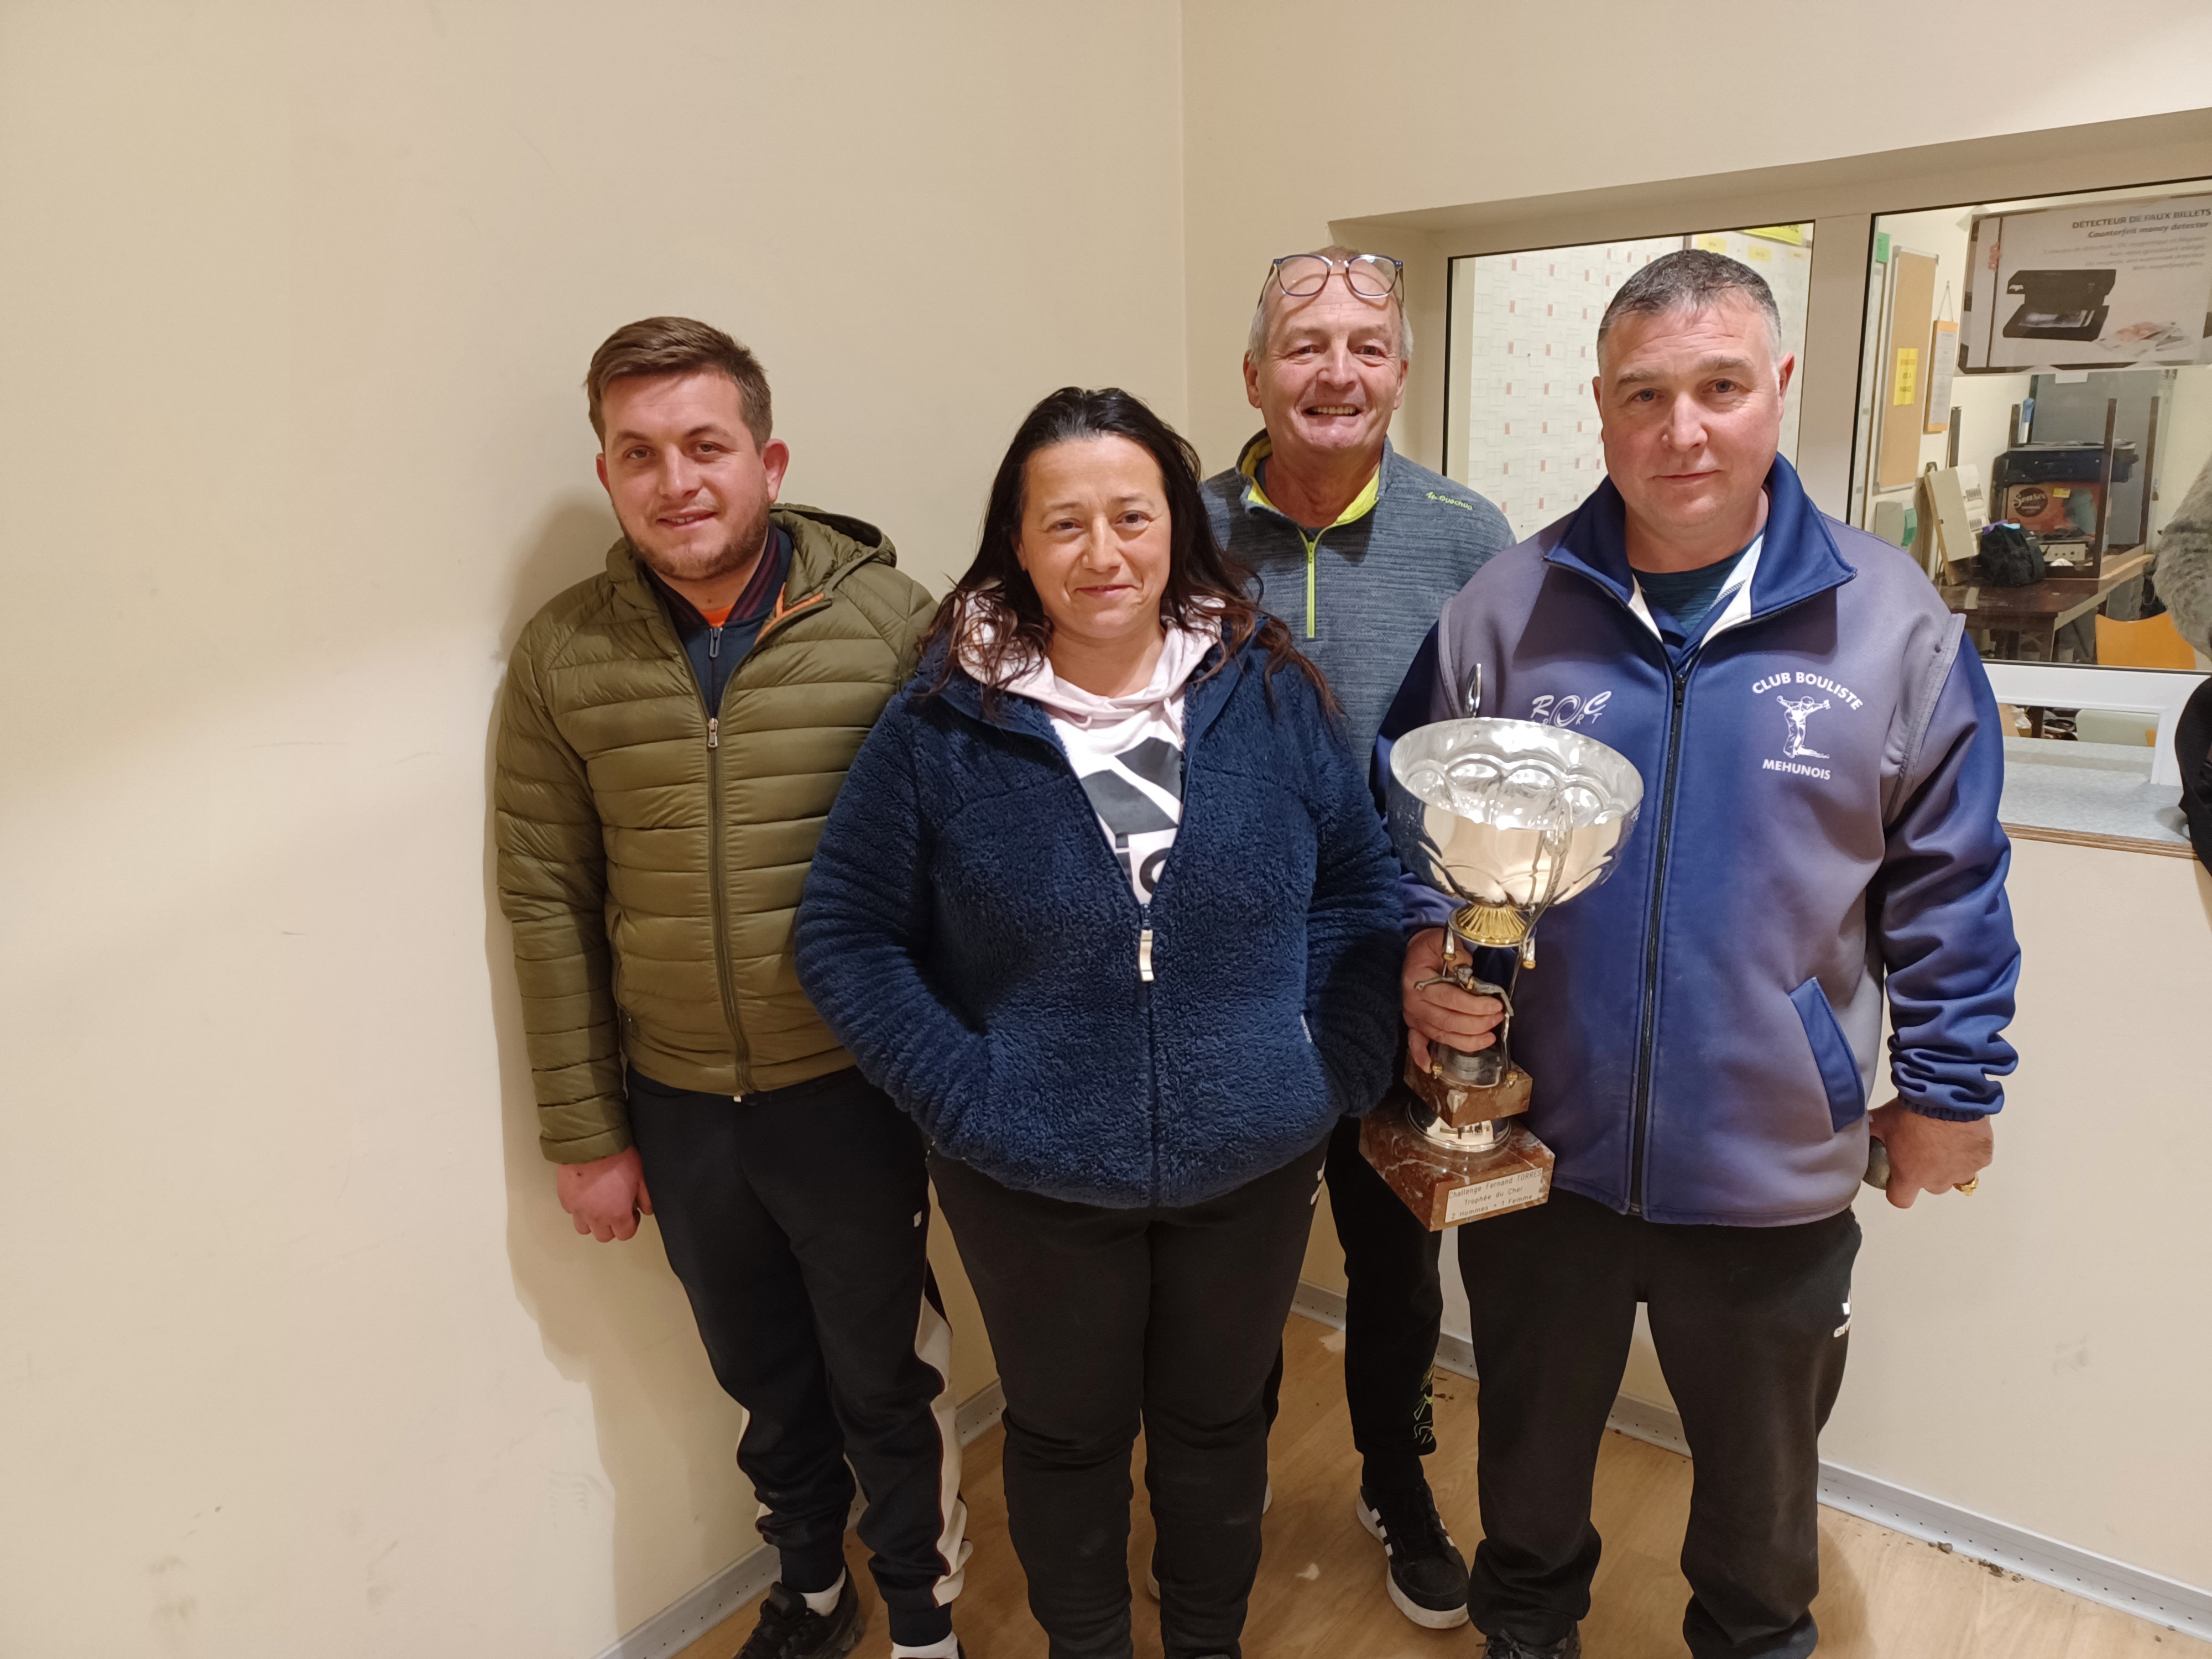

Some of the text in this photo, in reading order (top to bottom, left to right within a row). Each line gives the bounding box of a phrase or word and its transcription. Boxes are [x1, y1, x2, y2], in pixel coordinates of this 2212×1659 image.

[2144, 212, 2171, 221] FAUX
[2173, 208, 2212, 219] BILLETS
[2088, 221, 2209, 238] Counterfeit money detector
[1438, 495, 1473, 511] Quechua
[1752, 671, 1864, 711] CLUB BOULISTE
[1762, 759, 1831, 780] MEHUNOIS
[1449, 1169, 1542, 1199] Challenge Fernand TORRES
[1460, 1206, 1489, 1218] Hommes
[1509, 1194, 1533, 1205] Femme
[1465, 1194, 1491, 1206] Trophée
[1508, 1186, 1524, 1195] Cher
